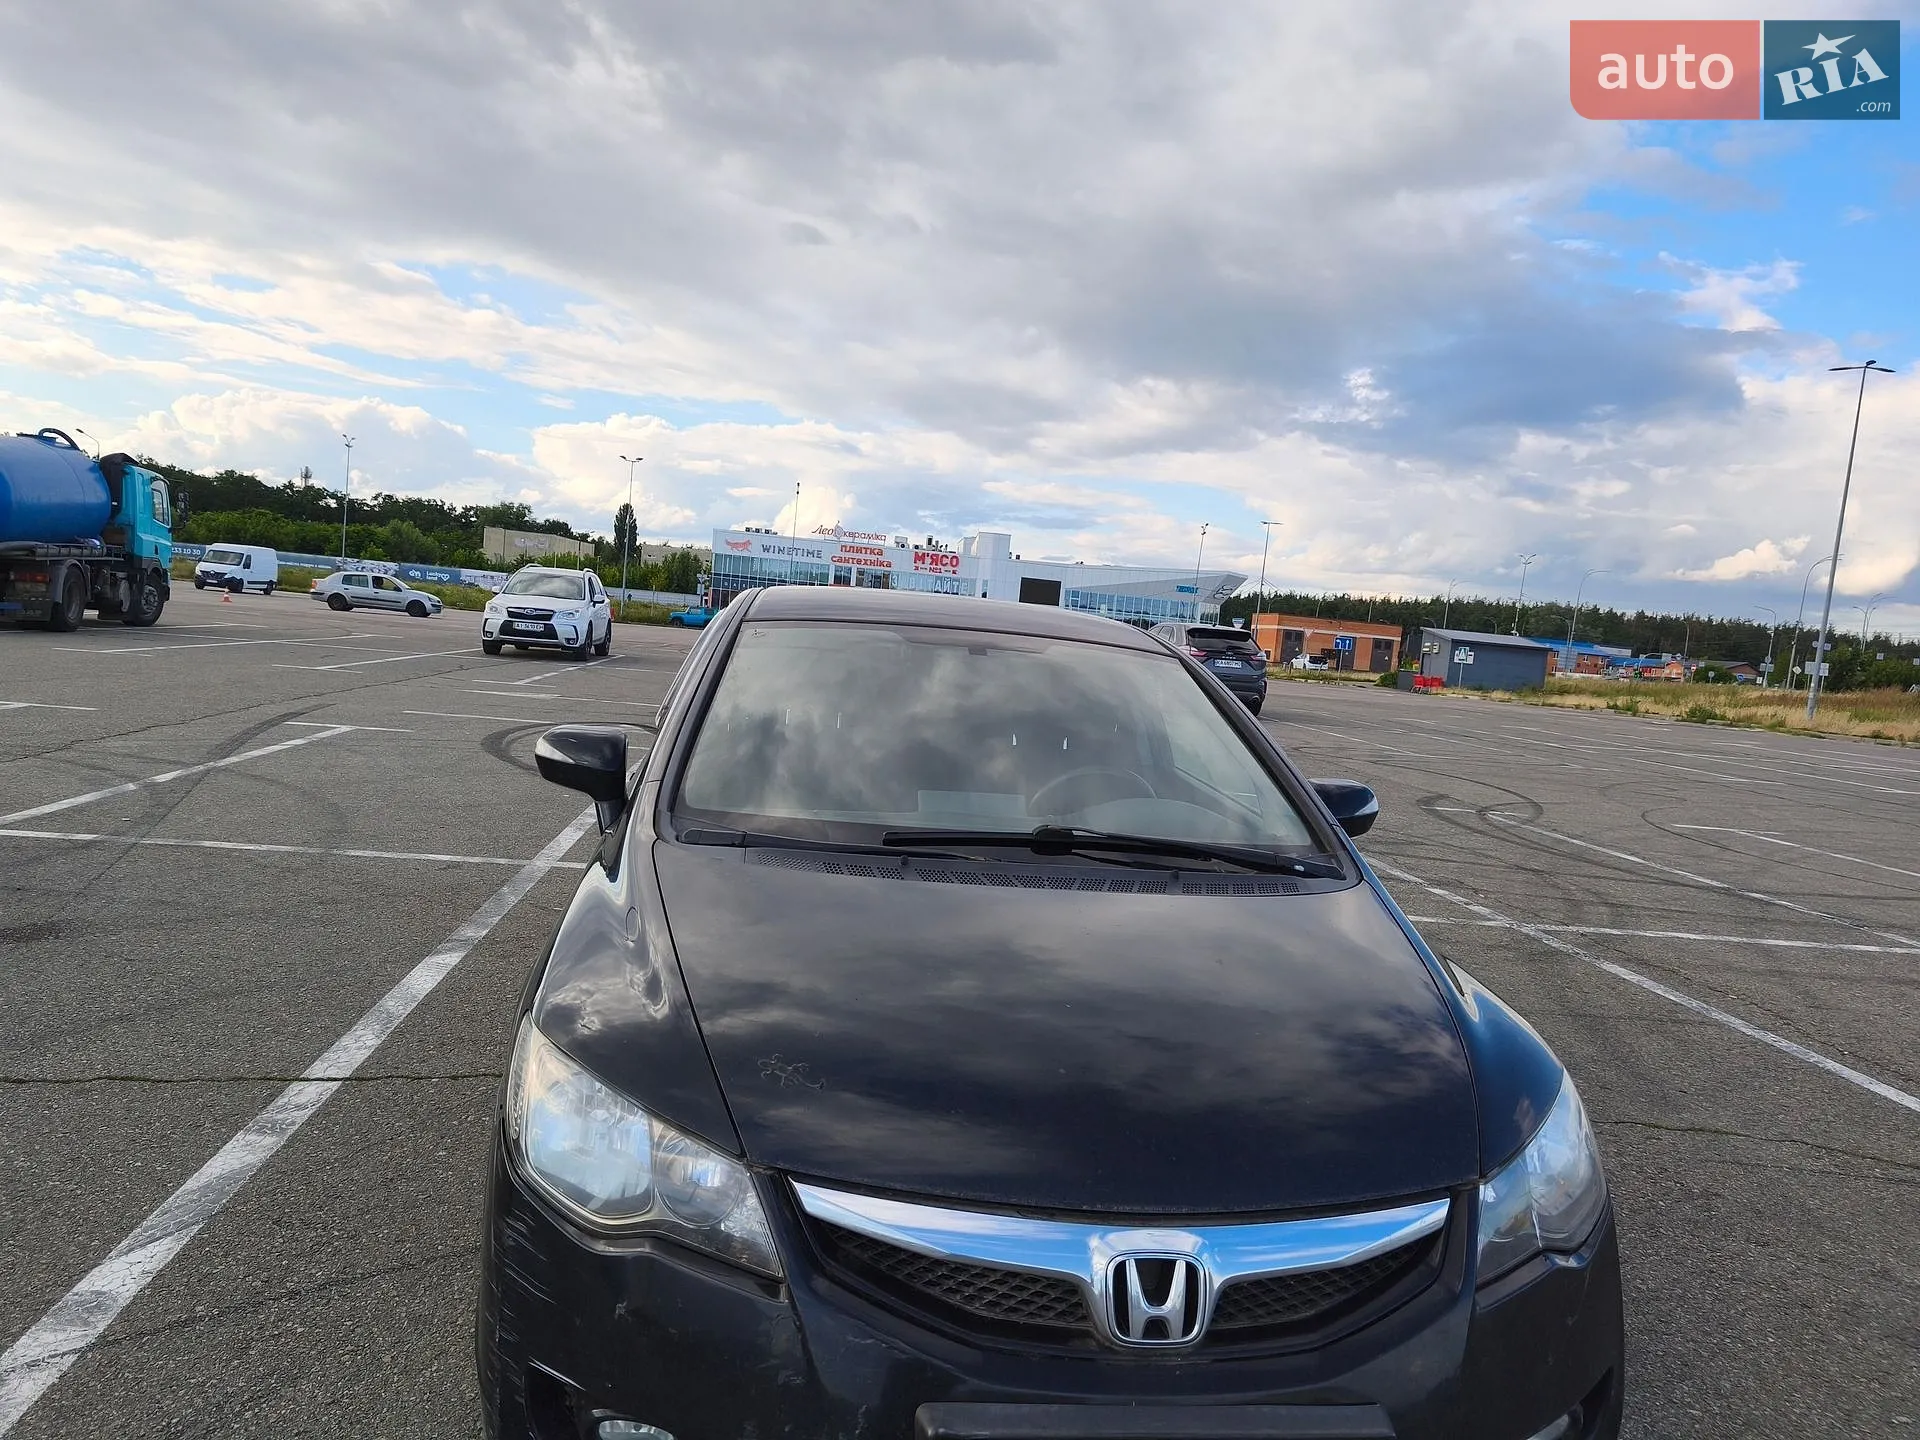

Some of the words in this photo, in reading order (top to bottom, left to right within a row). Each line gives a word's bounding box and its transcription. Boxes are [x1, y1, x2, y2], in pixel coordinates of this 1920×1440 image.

[843, 528, 887, 541] кераміка
[761, 543, 823, 559] WINETIME
[840, 544, 884, 556] плитка
[830, 555, 892, 568] сантехніка
[913, 551, 960, 568] М'ЯСО
